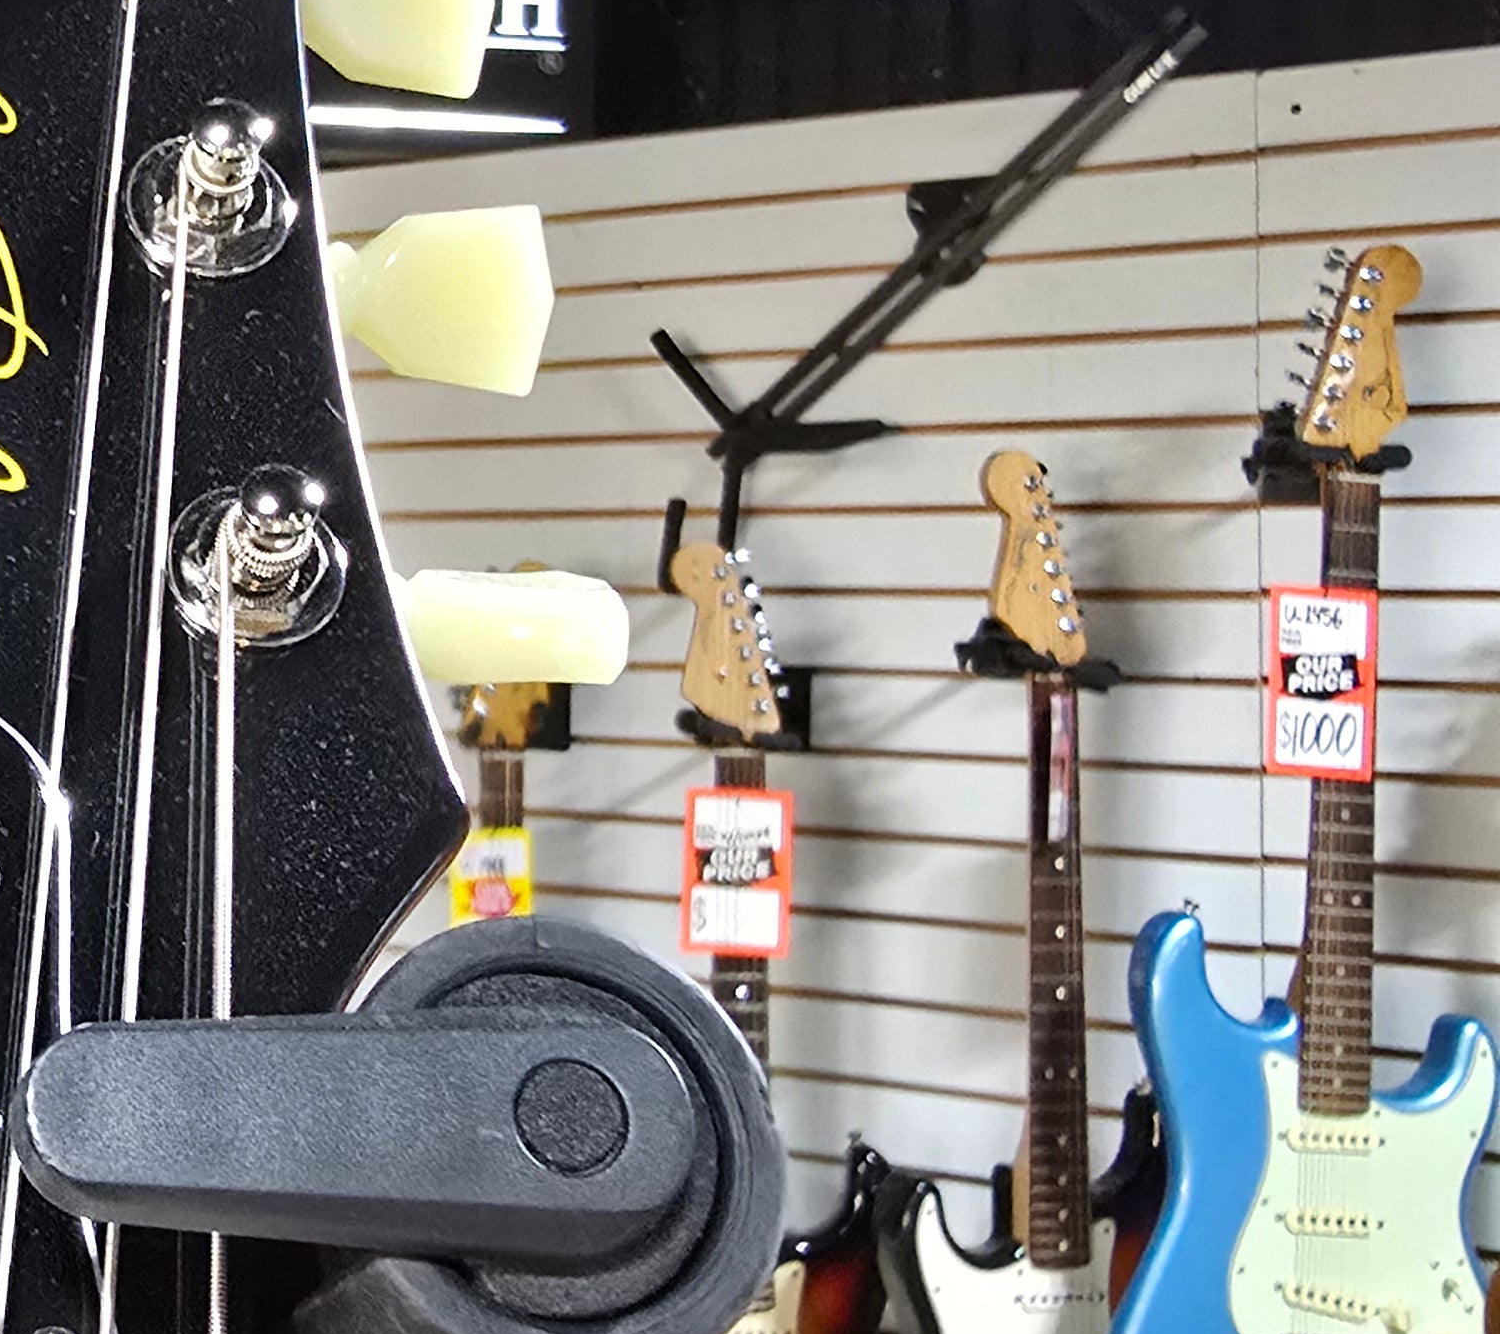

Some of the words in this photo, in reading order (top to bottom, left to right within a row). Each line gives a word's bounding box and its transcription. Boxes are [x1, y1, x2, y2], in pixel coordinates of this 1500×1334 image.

[1295, 655, 1344, 675] OUR
[1287, 669, 1355, 694] PRICE
[1278, 710, 1358, 758] $1000
